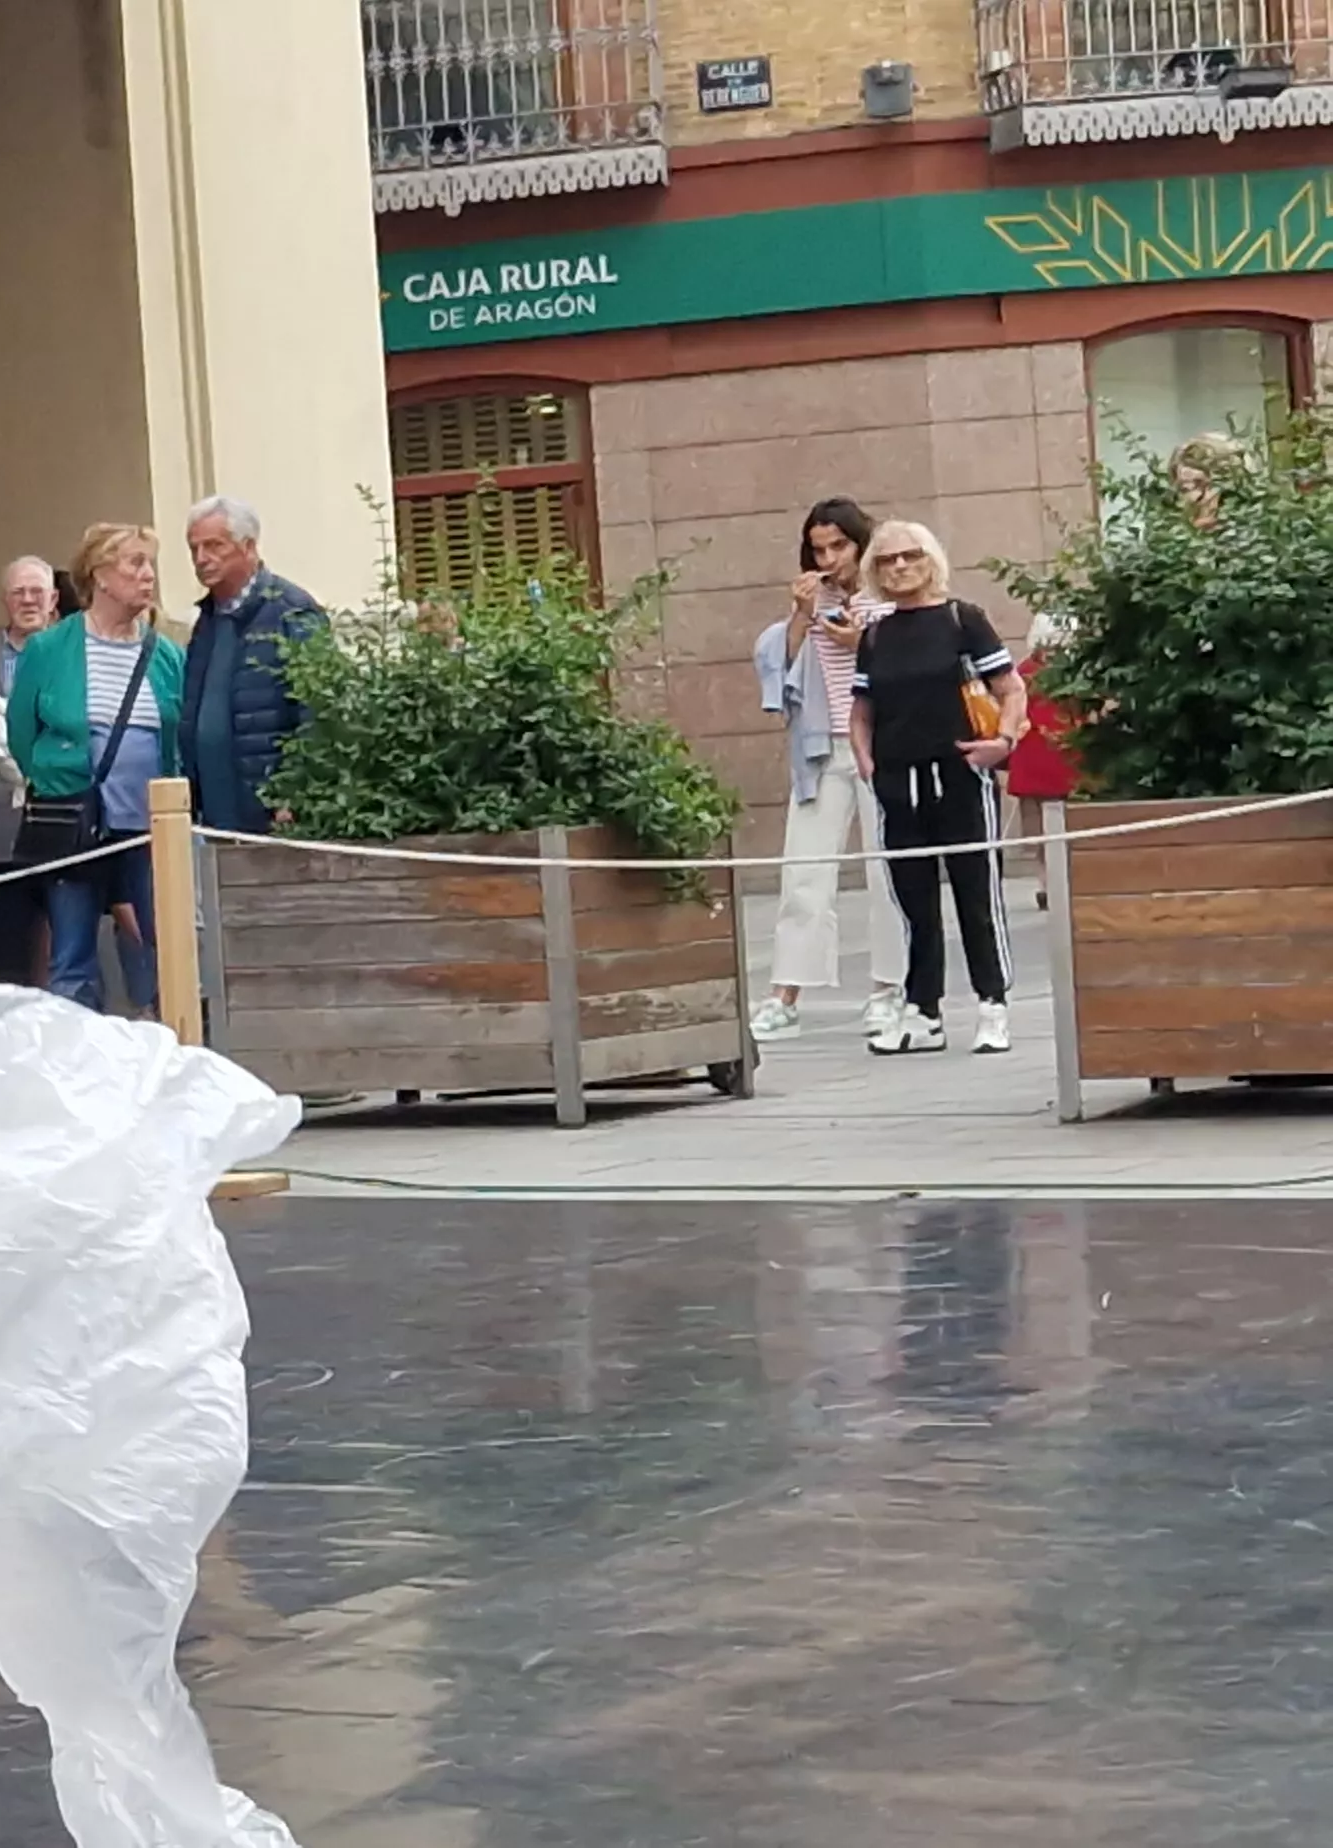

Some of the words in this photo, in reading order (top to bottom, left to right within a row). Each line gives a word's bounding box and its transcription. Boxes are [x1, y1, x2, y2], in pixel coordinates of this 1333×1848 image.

[707, 60, 759, 80] CALLE
[403, 267, 492, 303] CAJA
[499, 254, 618, 294] RURAL
[429, 307, 465, 331] DE
[474, 292, 596, 326] ARAGÓN
